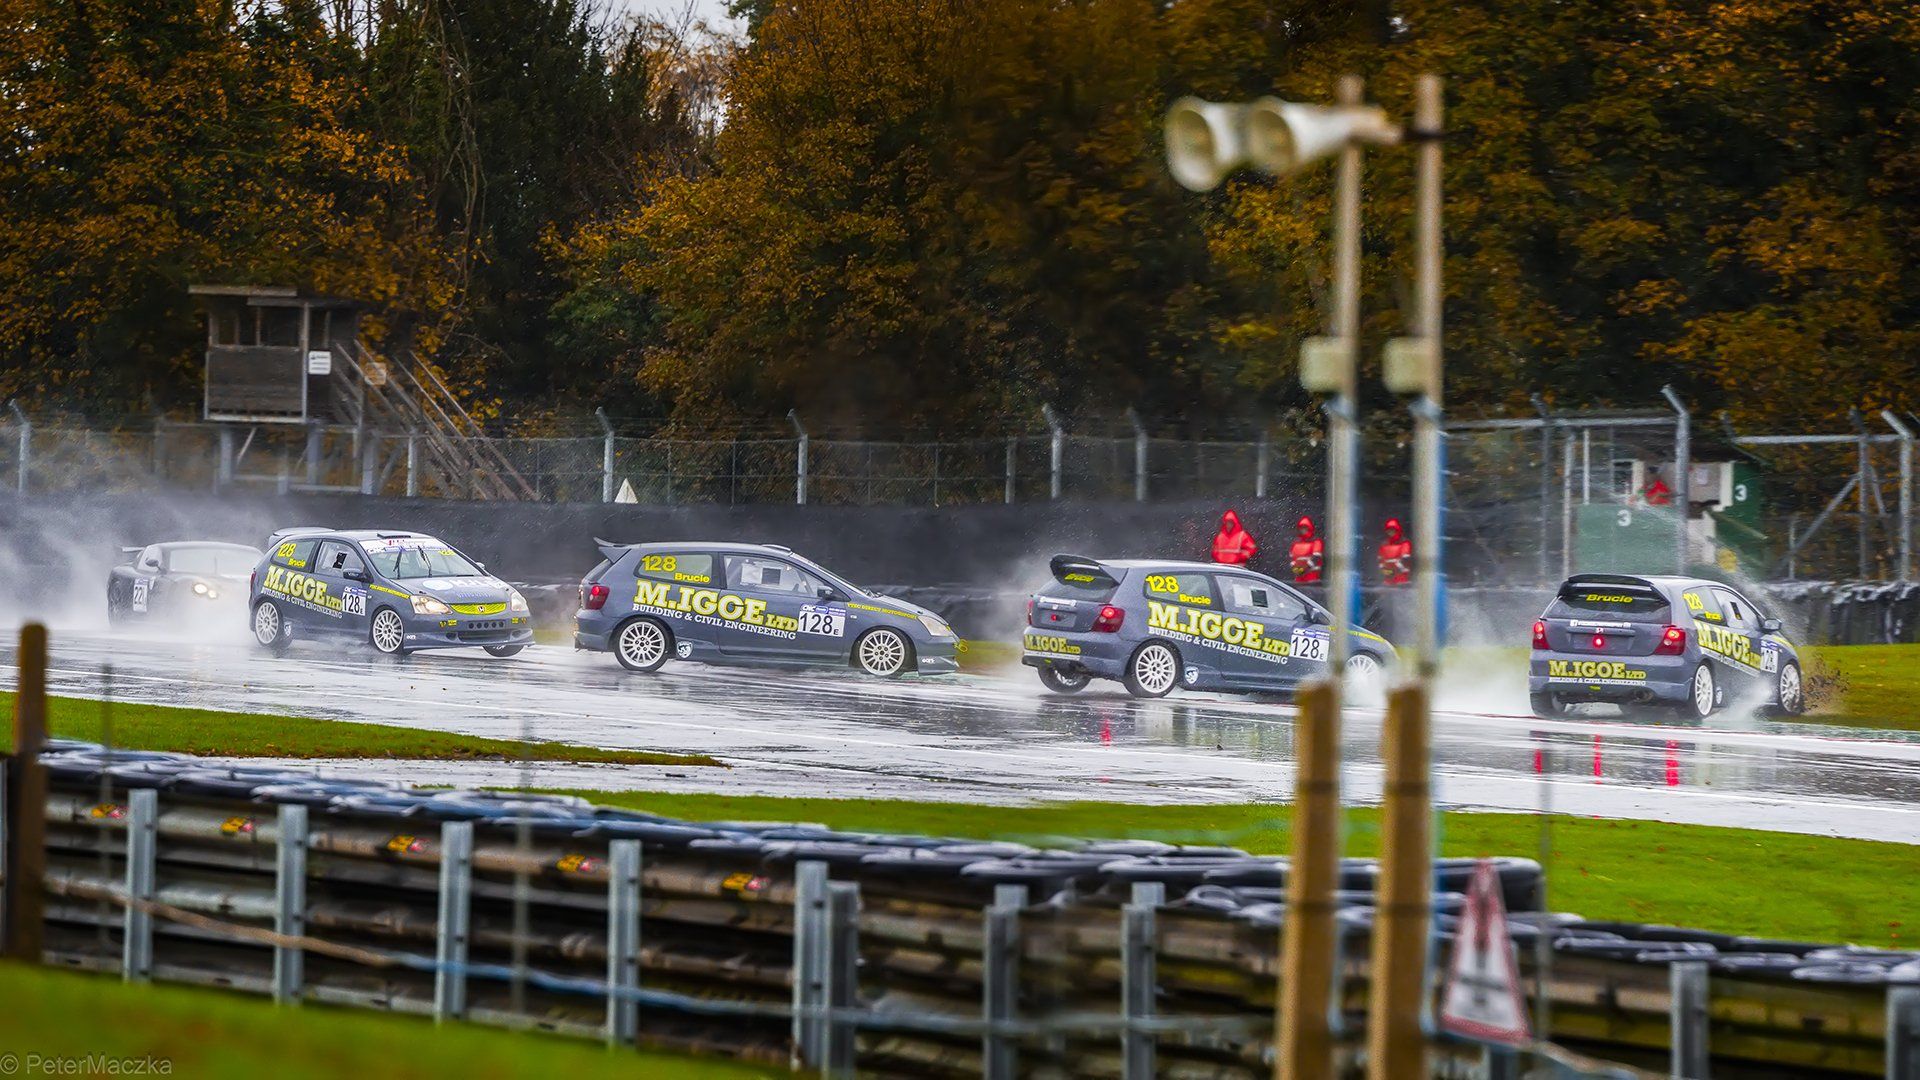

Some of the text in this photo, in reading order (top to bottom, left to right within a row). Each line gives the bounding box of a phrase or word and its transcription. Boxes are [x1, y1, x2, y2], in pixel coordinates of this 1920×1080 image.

[1735, 484, 1747, 501] 3
[1617, 509, 1631, 527] 3
[277, 543, 297, 558] 128
[641, 555, 677, 572] 128
[674, 572, 710, 583] Brucie
[1146, 575, 1179, 593] 128
[343, 593, 360, 613] 128
[1179, 593, 1212, 605] Brucie
[1586, 594, 1633, 603] Brucie
[1683, 592, 1704, 610] 128
[632, 603, 796, 640] BUILDING & CIVIL ENGINEERING
[765, 613, 798, 632] LTD
[800, 612, 833, 634] 128
[1148, 626, 1193, 643] BUILDING
[1201, 638, 1228, 652] CIVIL
[1227, 645, 1288, 665] ENGINEERING
[1262, 637, 1291, 656] LTD
[1291, 636, 1320, 659] 128
[1549, 660, 1647, 679] M.IGOE LTD
